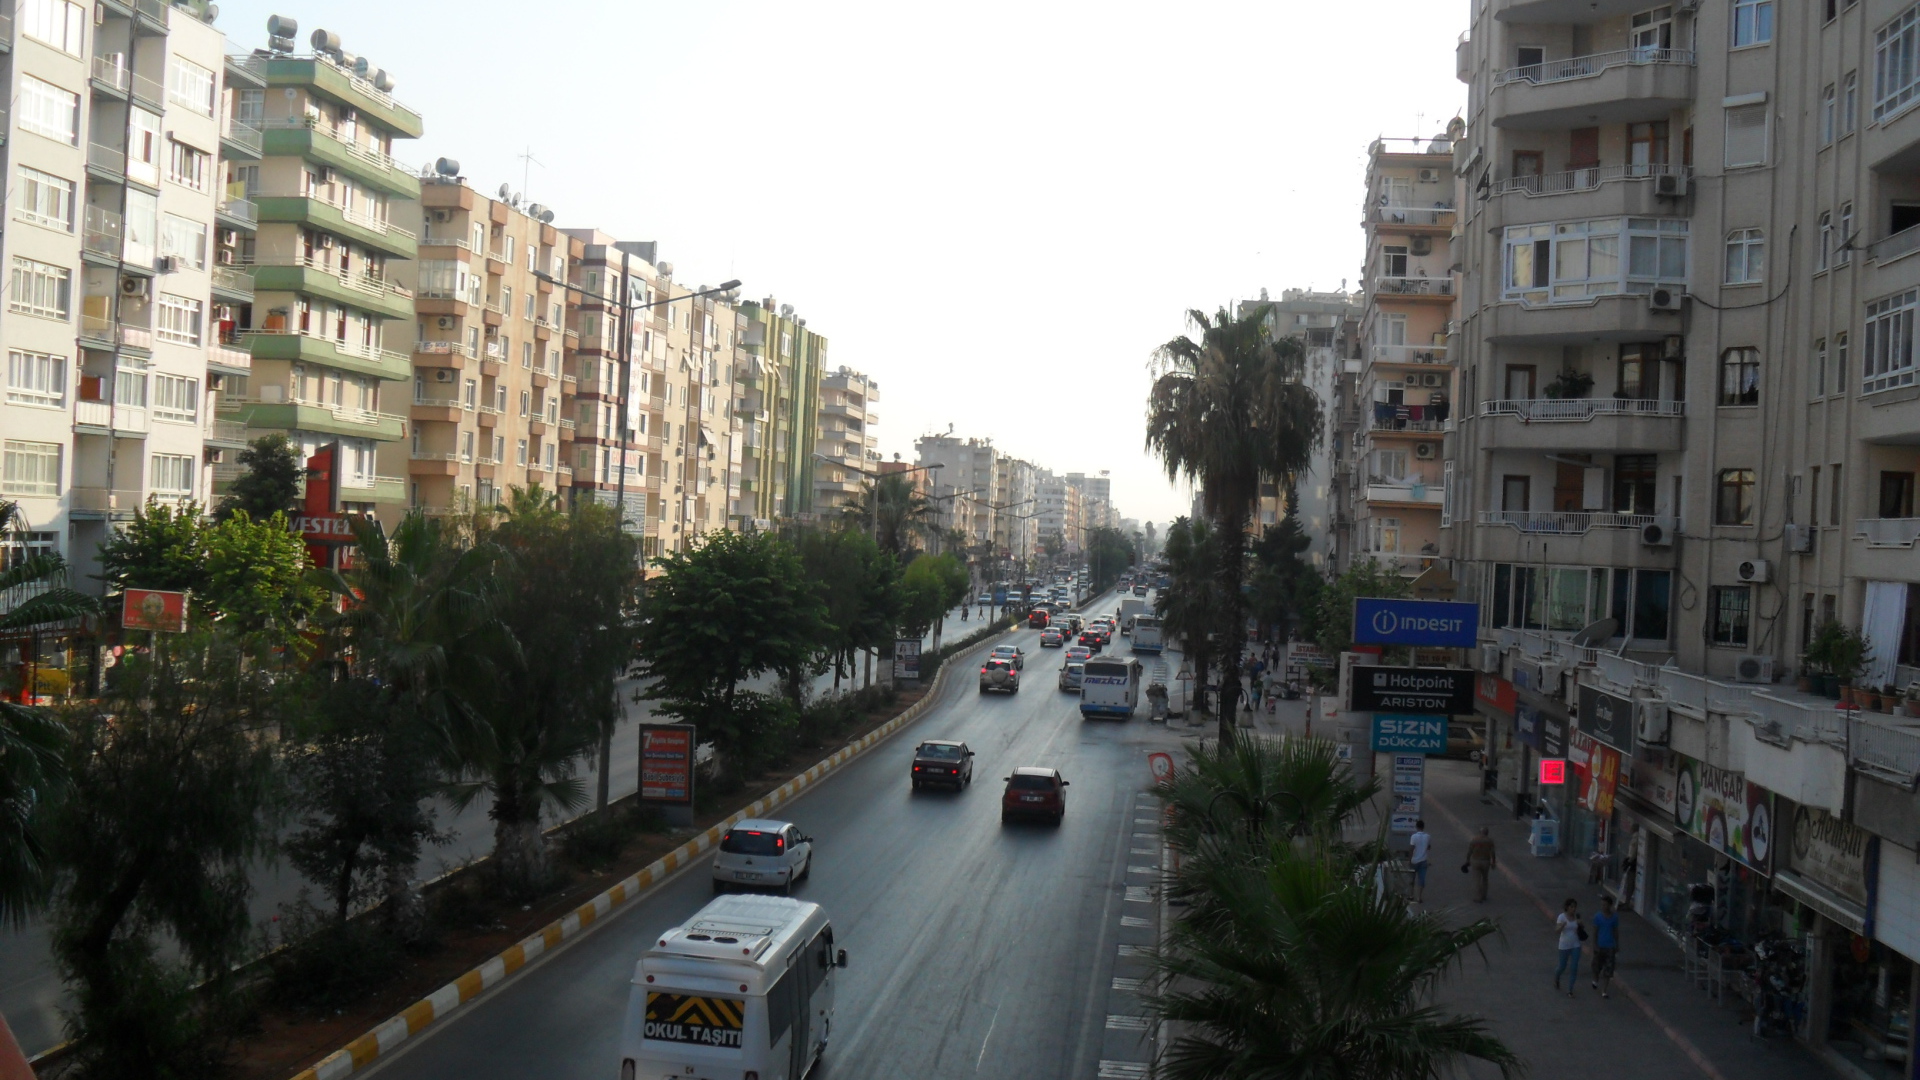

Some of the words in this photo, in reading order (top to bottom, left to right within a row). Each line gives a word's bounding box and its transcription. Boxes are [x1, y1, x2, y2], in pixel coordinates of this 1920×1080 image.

[288, 516, 353, 535] VESTEL
[1390, 674, 1454, 690] Hotpoint
[1381, 697, 1445, 708] ARISTON
[643, 732, 653, 749] 7
[1378, 736, 1441, 748] DÜKKAN
[1700, 761, 1743, 805] HANGAR
[645, 1022, 687, 1040] OKUL
[690, 1027, 742, 1047] TAŞITI
